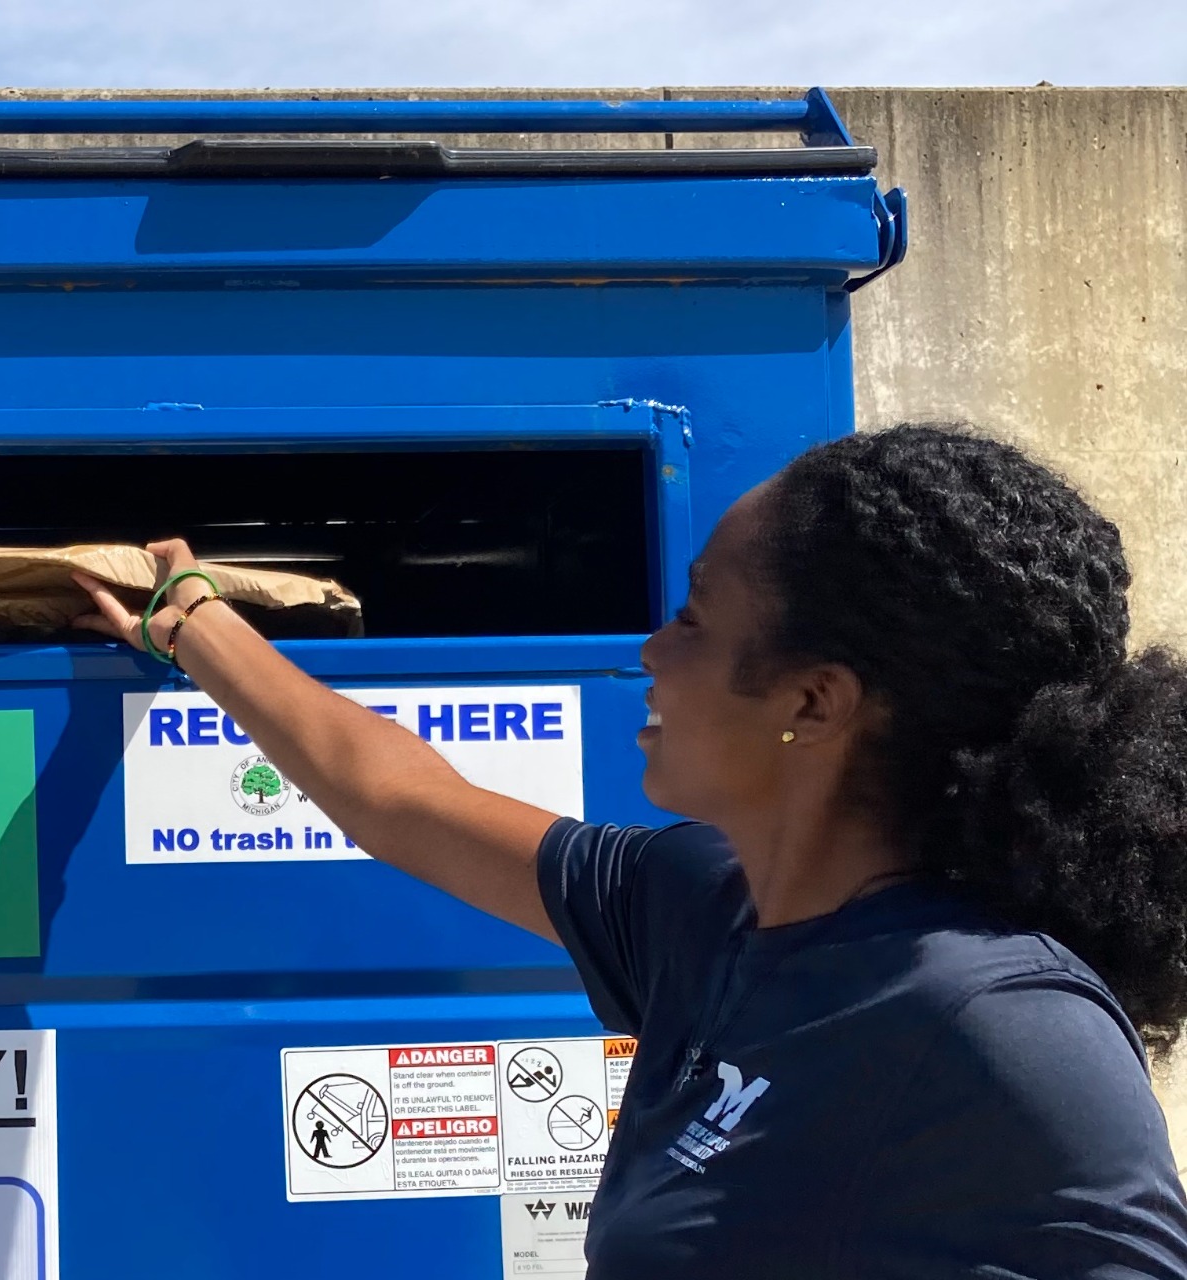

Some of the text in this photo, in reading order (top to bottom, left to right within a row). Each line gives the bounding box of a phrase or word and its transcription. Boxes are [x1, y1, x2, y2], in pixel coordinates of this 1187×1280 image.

[417, 703, 564, 742] HERE
[240, 760, 250, 770] OF
[232, 774, 240, 792] CITY
[241, 803, 281, 815] MICHIGAN
[152, 829, 199, 852] NO
[210, 827, 293, 851] trash
[304, 826, 332, 850] in
[410, 1049, 488, 1064] DANGER
[393, 1070, 492, 1080] Stand clear when container
[427, 1081, 455, 1090] ground.
[394, 1097, 400, 1105] IT
[411, 1096, 451, 1104] UNLAWFUL
[453, 1095, 462, 1103] TO
[464, 1094, 495, 1102] REMOVE
[394, 1107, 406, 1115] OR
[407, 1106, 436, 1114] DEFACE
[438, 1105, 454, 1113] THIS
[411, 1119, 492, 1135] PELIGRO
[507, 1153, 607, 1166] FALLING HAZARD
[396, 1171, 407, 1179] ES
[408, 1170, 434, 1178] ILEGAL
[436, 1169, 463, 1177] QUITAR
[510, 1169, 543, 1178] RIESGO
[545, 1169, 557, 1177] DE
[397, 1180, 417, 1188] ESTA
